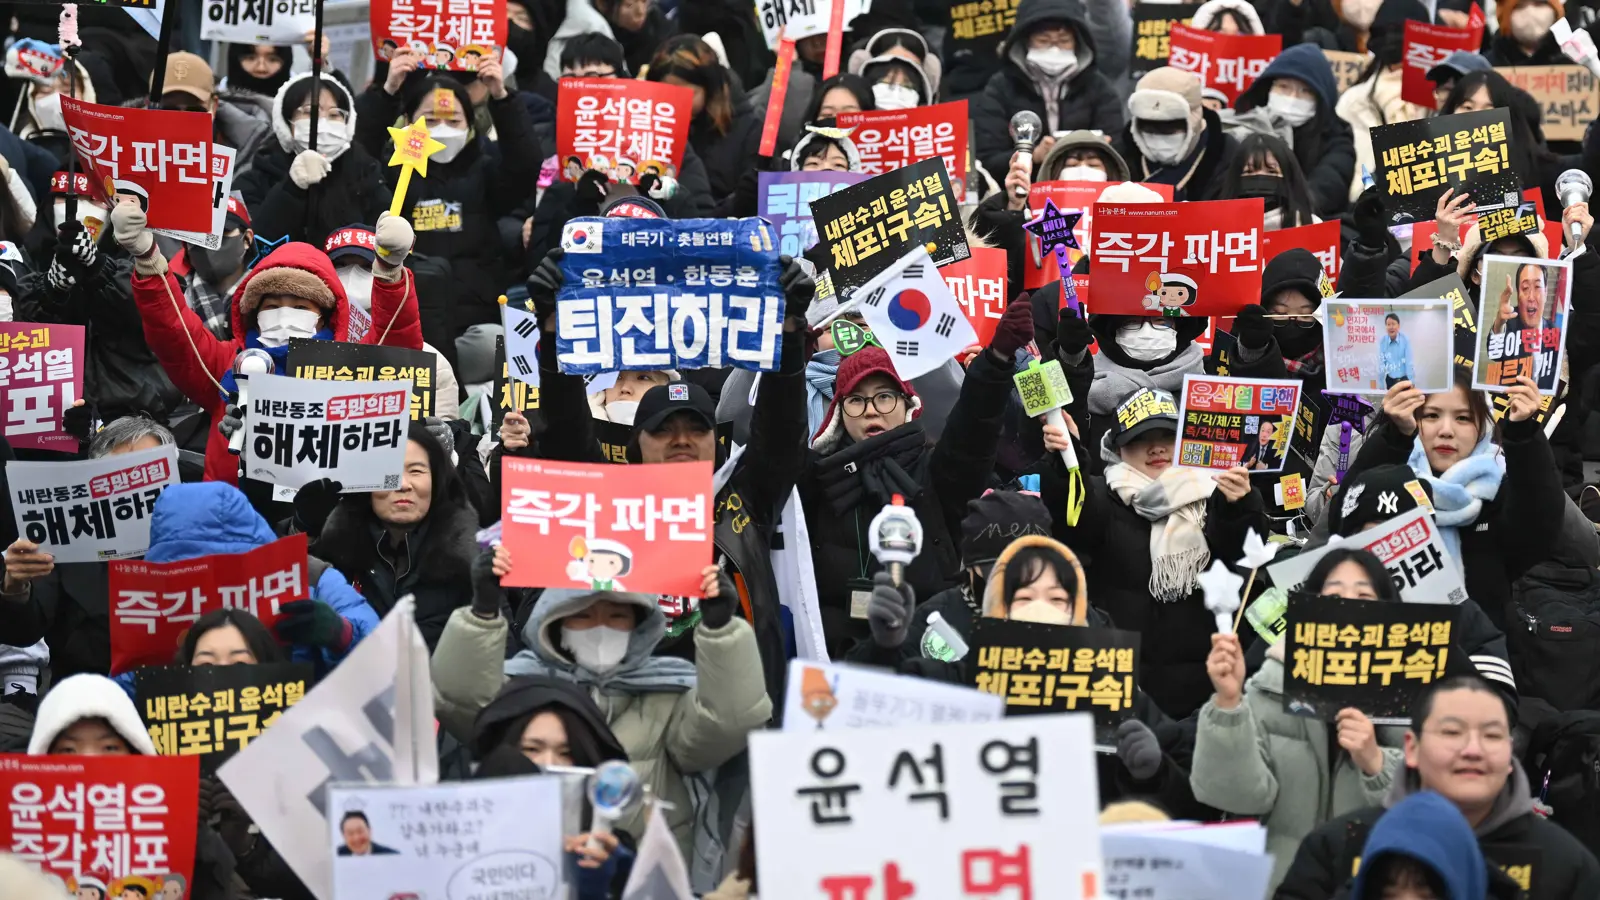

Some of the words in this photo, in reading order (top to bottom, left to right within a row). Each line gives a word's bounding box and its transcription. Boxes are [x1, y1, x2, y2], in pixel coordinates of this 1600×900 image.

[388, 13, 443, 47] 즉각
[445, 16, 496, 46] 체포
[574, 96, 677, 134] 윤석열은
[68, 125, 124, 180] 즉각
[131, 139, 208, 185] 파면
[572, 129, 626, 160] 즉각
[627, 131, 675, 164] 체포
[857, 122, 956, 160] 윤석열은
[1382, 134, 1452, 168] 내란수괴
[1454, 121, 1507, 150] 윤석열
[58, 174, 88, 191] 윤열
[1386, 143, 1510, 196] 체포!구속!
[824, 197, 889, 241] 내란수괴
[890, 172, 944, 209] 윤석열
[1098, 206, 1127, 216] 나눔문화
[325, 231, 353, 250] 윤석열
[621, 231, 664, 247] 태극기
[677, 231, 733, 247] 촛불연합
[831, 194, 953, 271] 체포!구속!
[1095, 231, 1175, 273] 즉각
[1182, 227, 1258, 274] 파면
[683, 264, 760, 288] 한동훈
[558, 293, 783, 369] 퇴진하라
[836, 325, 859, 350] 탄
[1488, 330, 1521, 360] 좋아
[1521, 327, 1561, 353] 탄핵
[377, 366, 431, 388] 윤석열
[254, 399, 325, 419] 내란동조
[1026, 396, 1051, 410] GOGO
[1189, 382, 1254, 410] 윤석열
[1260, 386, 1295, 412] 탄핵
[1185, 425, 1240, 441] 즉/각/탄/핵
[1187, 412, 1242, 428] 즉/각/체/포
[253, 419, 403, 469] 해체하라
[17, 483, 90, 506] 내란동조
[1377, 490, 1399, 514] NY
[507, 488, 602, 540] 즉각
[611, 493, 706, 541] 파면
[149, 563, 209, 576] www.nanum.com
[114, 587, 208, 635] 즉각
[217, 562, 302, 621] 파면
[1295, 622, 1384, 649] 내란수괴
[1387, 620, 1452, 648] 윤석열
[978, 646, 1071, 673] 내란수괴
[1073, 647, 1134, 673] 윤석열
[1292, 648, 1449, 687] 체포!구속!
[146, 688, 235, 721] 내란수괴
[239, 680, 305, 712] 윤석열
[975, 672, 1134, 712] 체포!구속!
[8, 782, 169, 831] 윤석열은
[11, 832, 87, 878] 즉각
[90, 832, 171, 878] 체포
